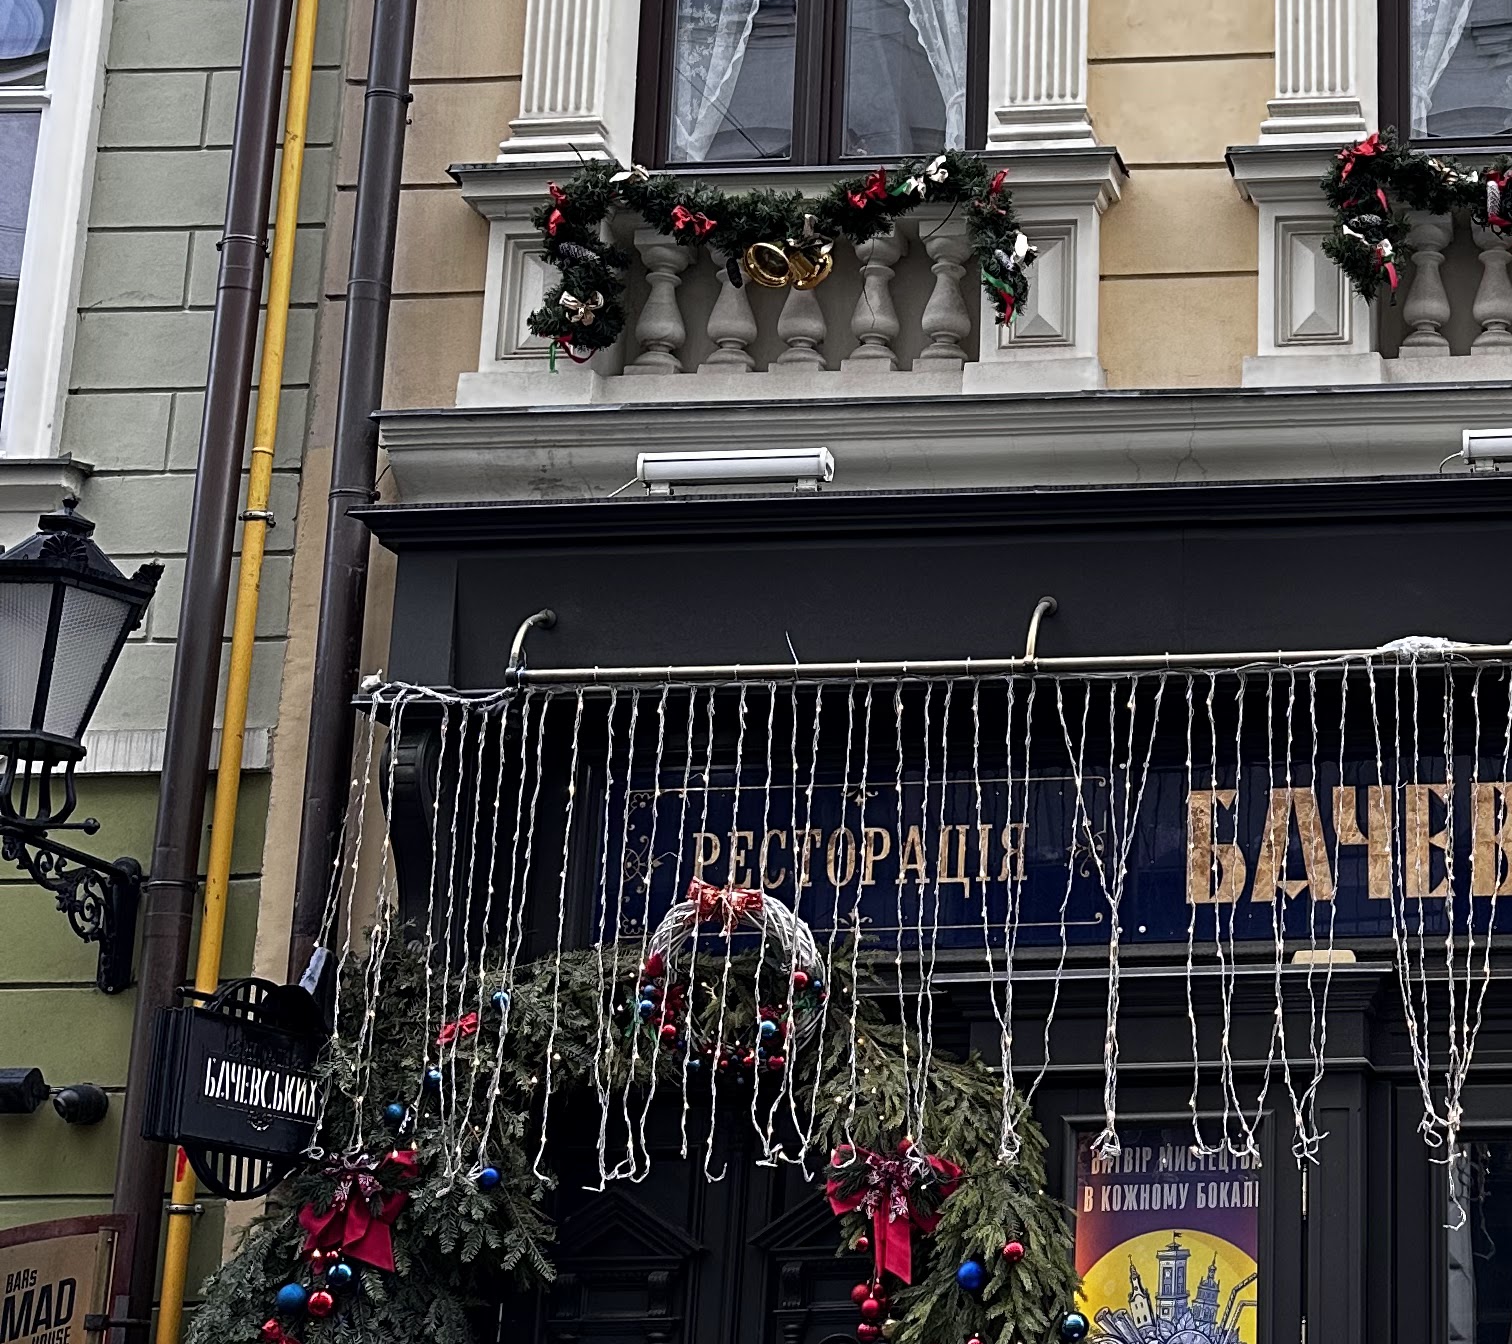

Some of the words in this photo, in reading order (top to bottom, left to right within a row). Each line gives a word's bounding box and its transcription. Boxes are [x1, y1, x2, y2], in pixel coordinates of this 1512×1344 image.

[692, 822, 1030, 899] РЕСТОРАЦІЯ
[204, 1056, 318, 1118] БАЧЕВСЬКИХ
[1084, 1186, 1094, 1213] В
[1101, 1182, 1189, 1212] КОЖНОМУ
[1196, 1180, 1259, 1209] БОКАЛІ
[0, 1277, 76, 1344] MAD
[6, 1268, 37, 1294] BARS
